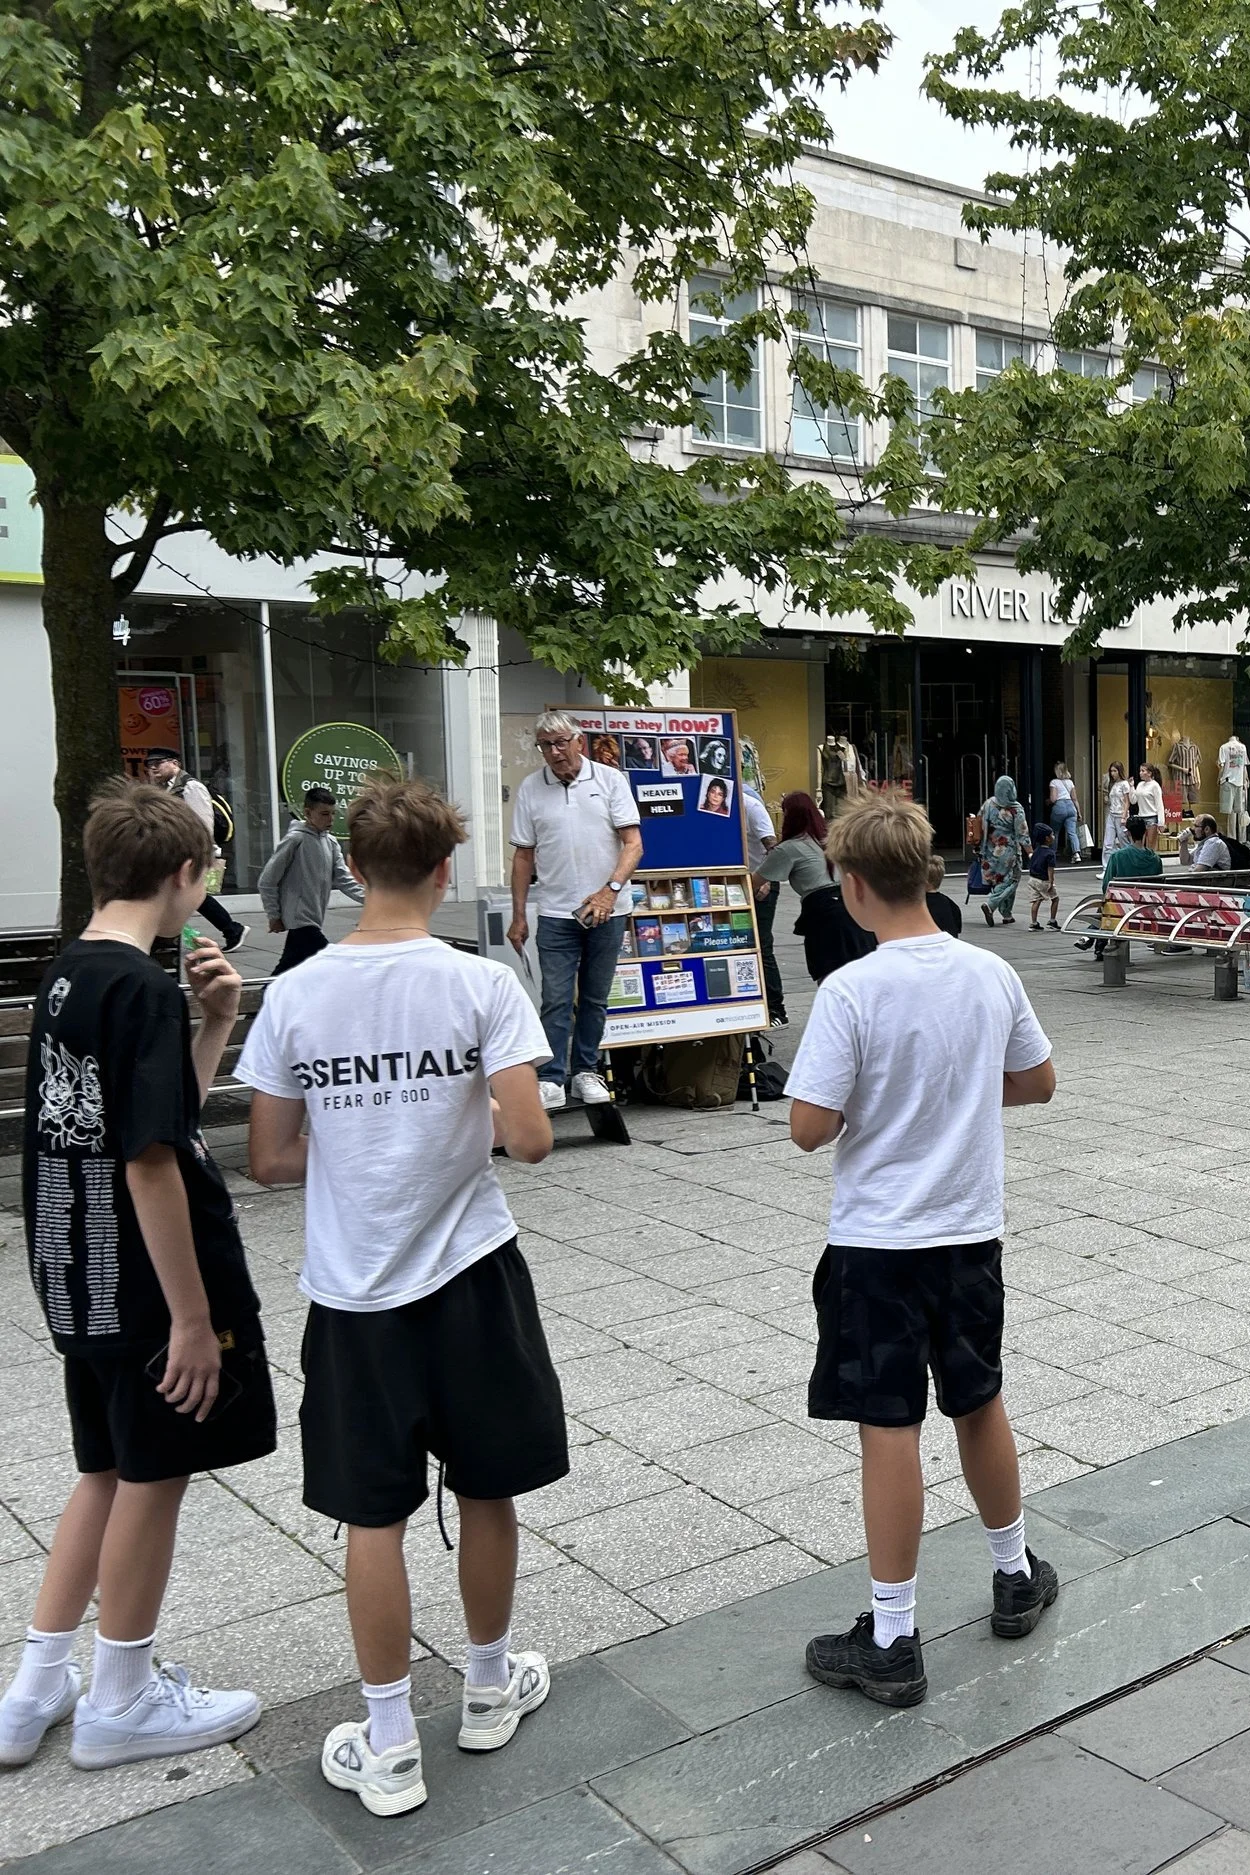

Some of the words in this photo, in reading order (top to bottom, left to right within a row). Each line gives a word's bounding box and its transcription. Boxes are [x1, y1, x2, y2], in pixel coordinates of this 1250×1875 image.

[951, 584, 1030, 622] RIVER
[608, 719, 630, 729] are
[634, 719, 663, 731] they
[668, 717, 719, 733] now?
[314, 753, 378, 771] SAVINGS
[324, 768, 345, 781] UP
[347, 771, 367, 783] TO
[642, 788, 678, 798] HEAVEN
[650, 804, 674, 814] HELL
[703, 937, 728, 946] Please
[729, 935, 748, 944] take!
[646, 1019, 677, 1028] MISSION
[323, 1093, 364, 1111] FEAR
[373, 1090, 393, 1106] OF
[401, 1087, 430, 1104] GOD
